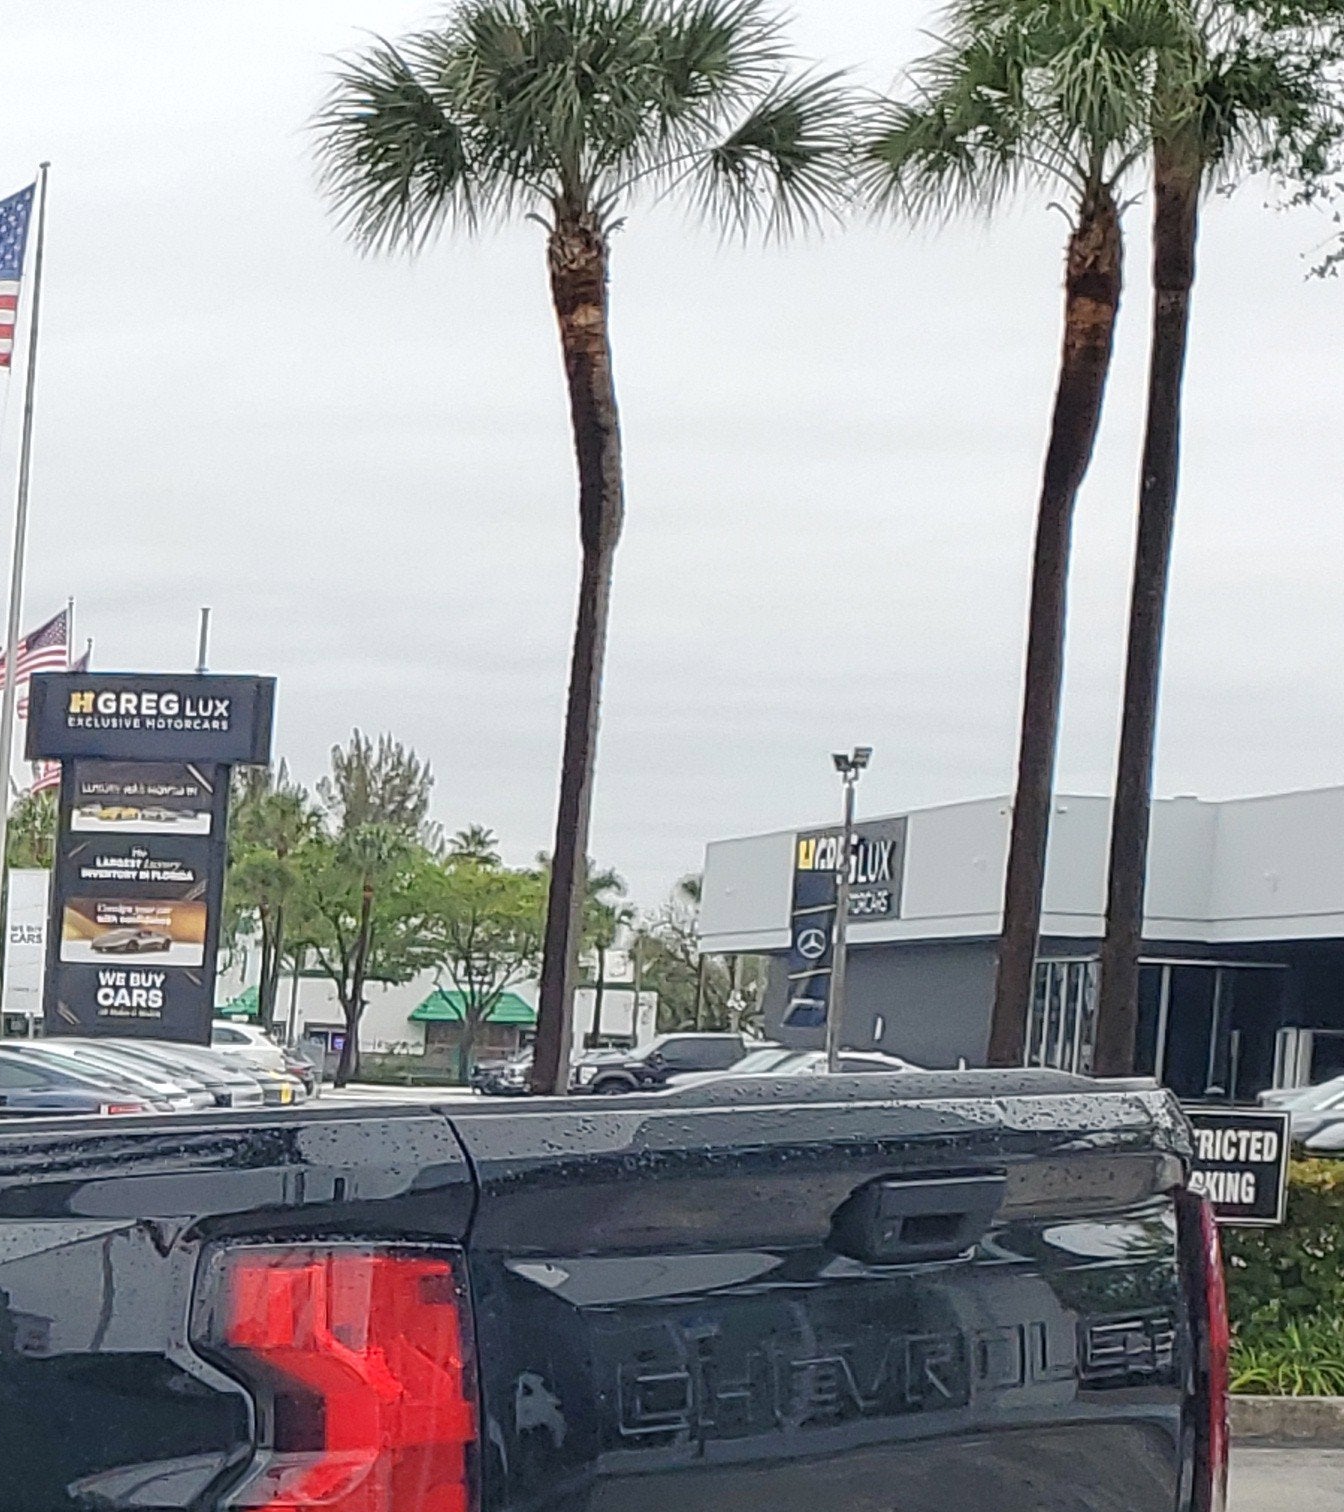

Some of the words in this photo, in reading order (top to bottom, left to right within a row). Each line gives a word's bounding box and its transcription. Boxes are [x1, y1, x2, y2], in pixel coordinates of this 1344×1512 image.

[185, 699, 230, 717] LUX
[68, 716, 141, 729] EXCLUSIVE
[146, 718, 229, 731] MOTORCARS
[858, 840, 892, 883] LUX
[10, 933, 43, 944] CARS
[98, 970, 127, 987] WE
[130, 971, 166, 989] BUY
[96, 988, 163, 1009] CARS
[618, 1315, 1177, 1437] CHEVROLET
